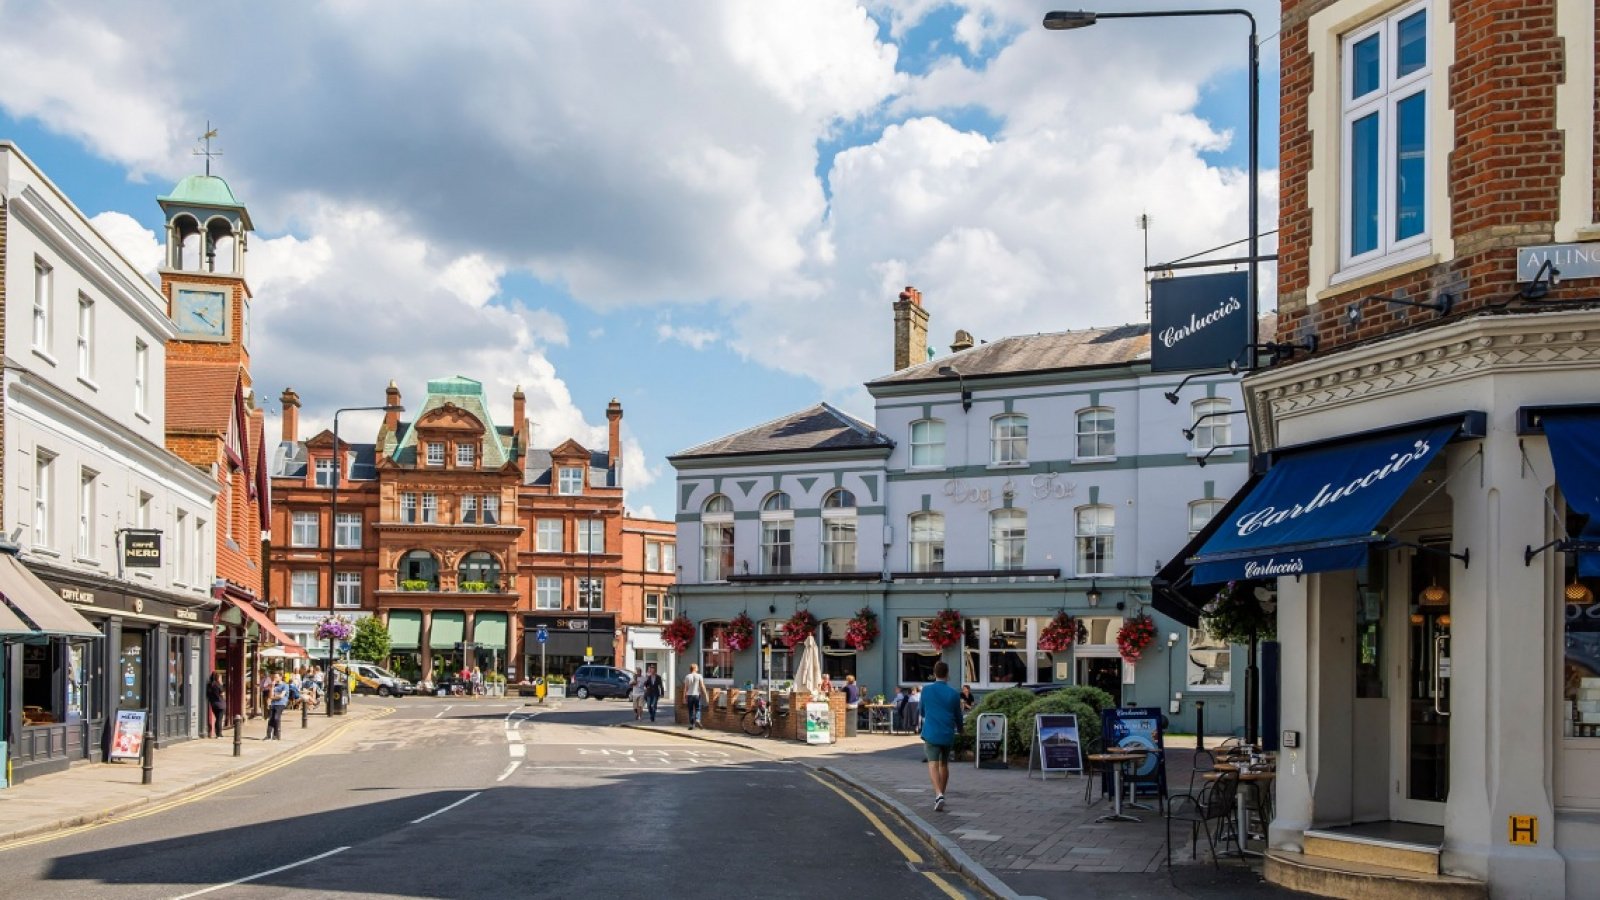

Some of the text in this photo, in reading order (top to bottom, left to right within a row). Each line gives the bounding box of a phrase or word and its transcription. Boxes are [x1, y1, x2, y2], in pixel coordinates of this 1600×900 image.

[1159, 296, 1240, 347] Carluccio's
[1236, 440, 1430, 536] Carluccio's
[126, 549, 159, 557] NERO
[1245, 558, 1303, 579] Carluccio's
[1512, 816, 1535, 842] H
